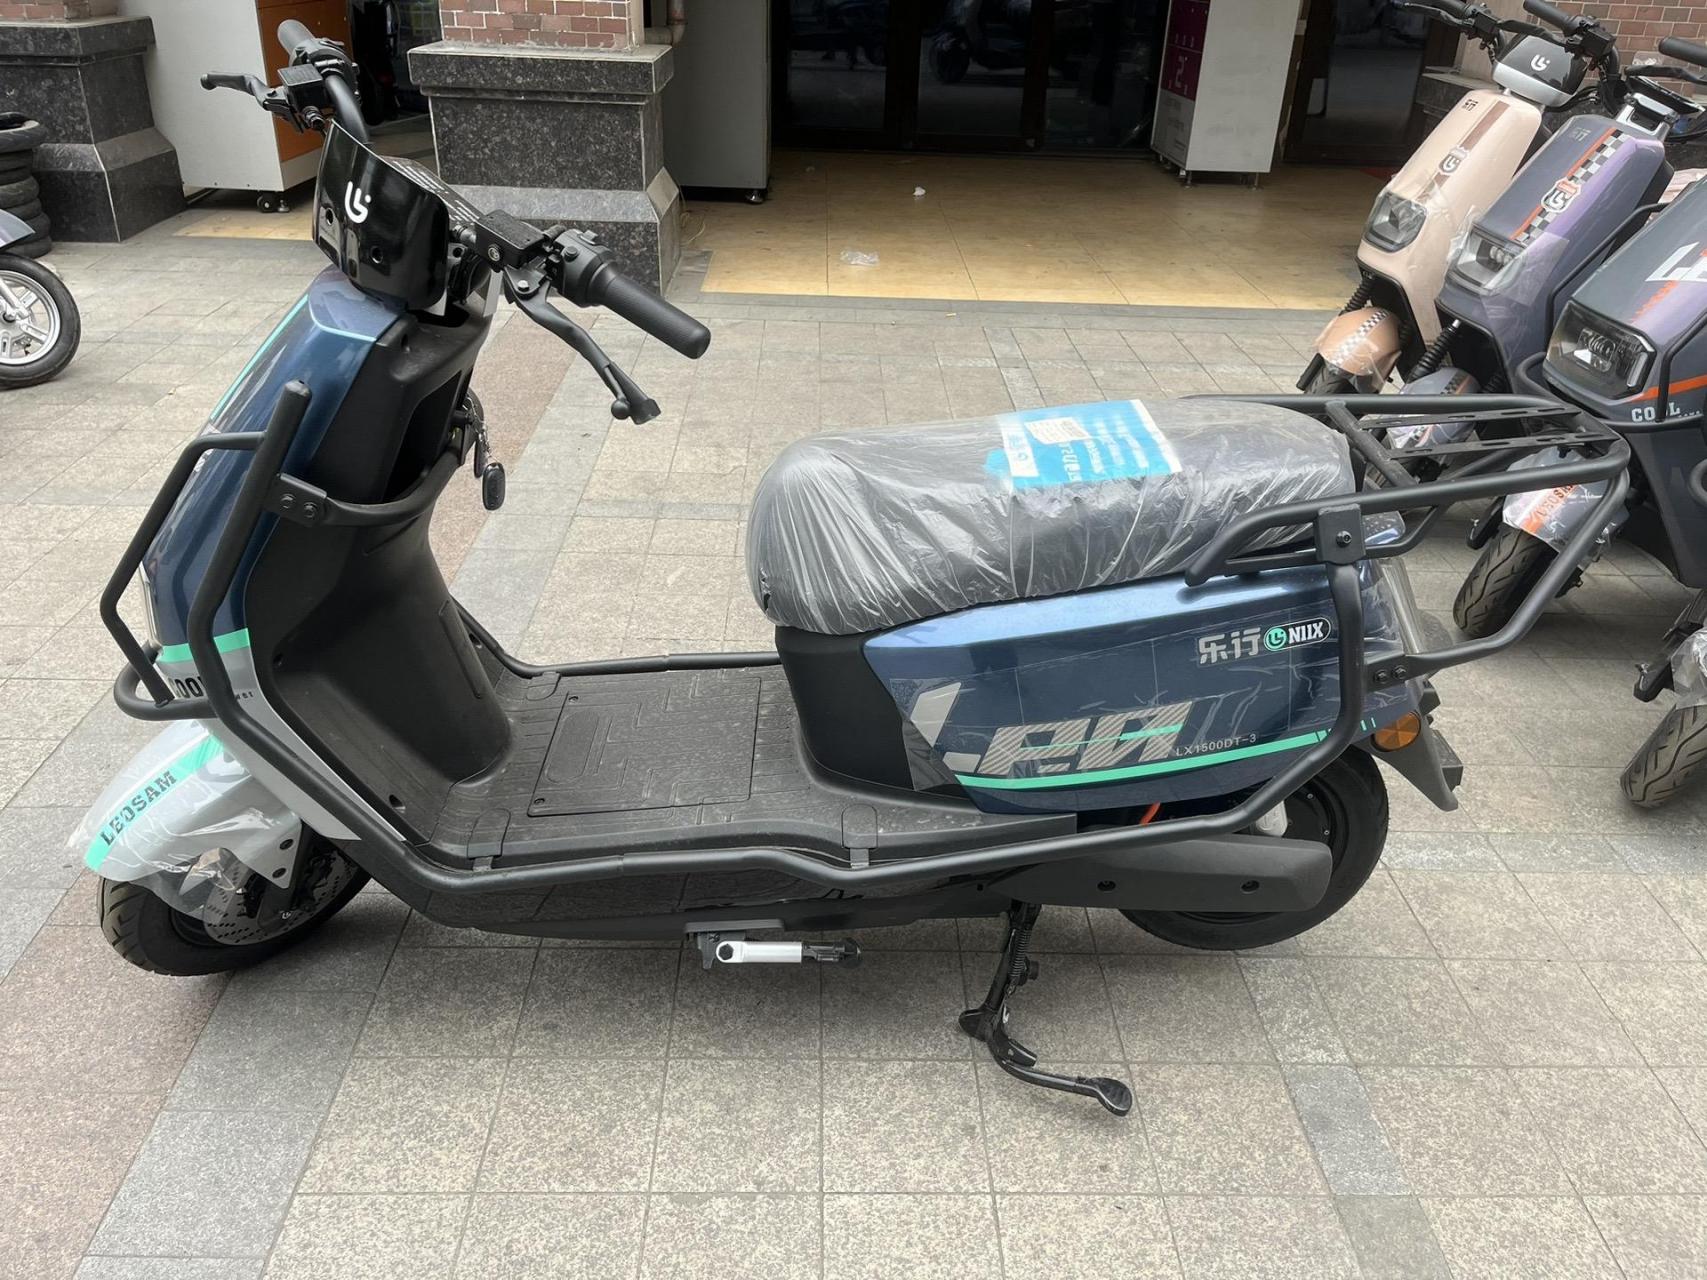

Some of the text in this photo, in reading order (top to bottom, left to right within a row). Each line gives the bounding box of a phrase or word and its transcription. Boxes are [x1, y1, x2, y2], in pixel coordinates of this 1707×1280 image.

[1631, 401, 1681, 422] COL
[1198, 627, 1261, 665] 乐行
[1175, 733, 1257, 757] LX1500DT-3
[100, 770, 177, 846] LEOSAM
